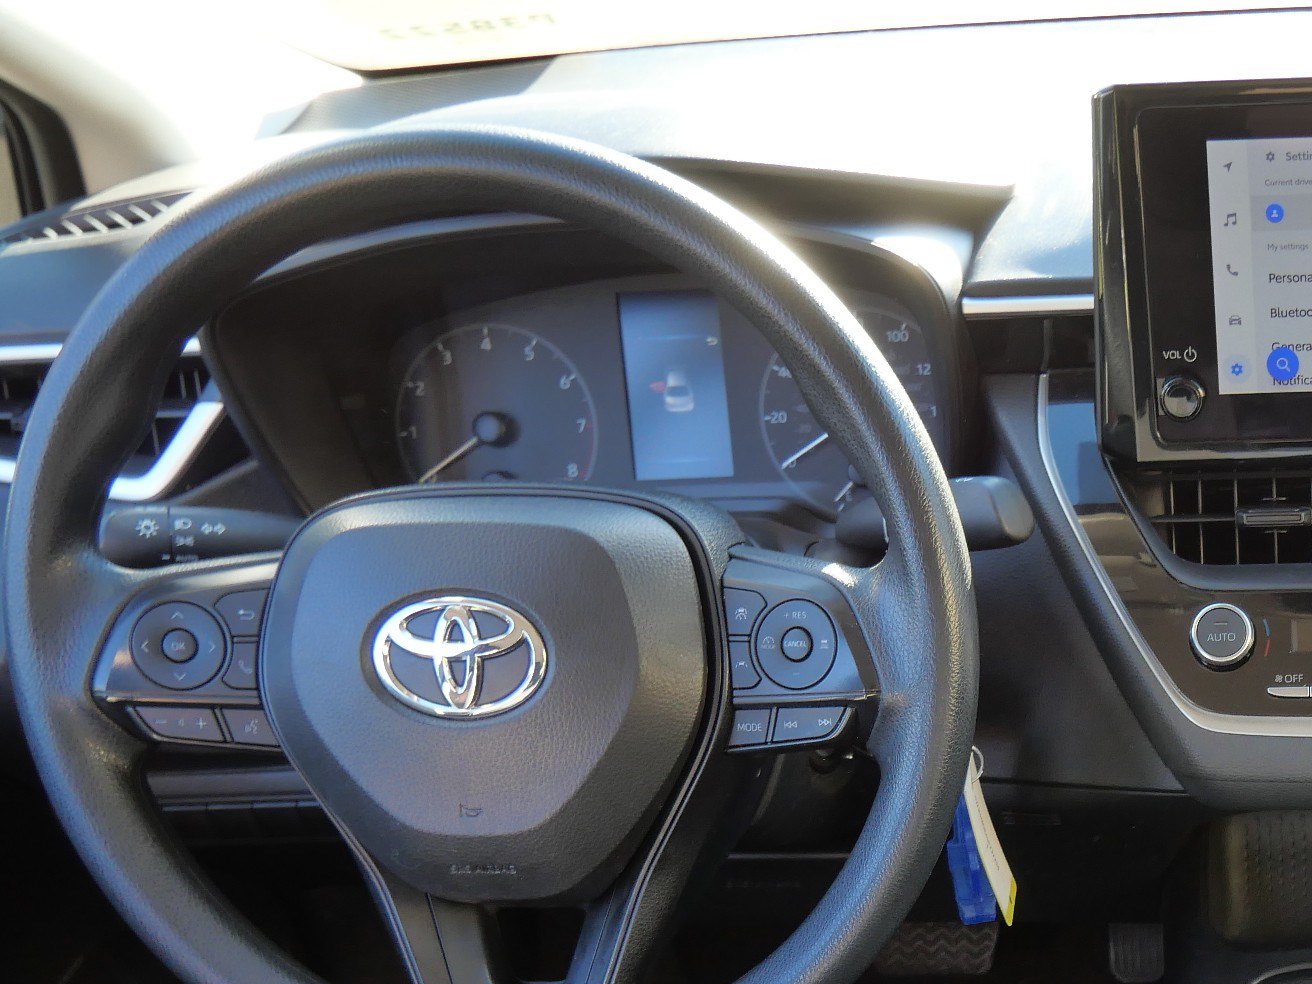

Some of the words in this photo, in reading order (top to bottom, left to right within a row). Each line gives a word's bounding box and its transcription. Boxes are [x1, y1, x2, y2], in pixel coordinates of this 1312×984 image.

[1264, 178, 1293, 186] Current
[1267, 243, 1278, 252] My
[1280, 243, 1309, 252] settings
[886, 330, 909, 343] 100
[1163, 350, 1182, 360] VOL
[769, 411, 787, 424] 20
[792, 611, 807, 620] RES
[1207, 632, 1236, 642] AUTO
[784, 640, 807, 648] CANCEL
[1284, 674, 1304, 683] OFF
[737, 722, 763, 732] MODE
